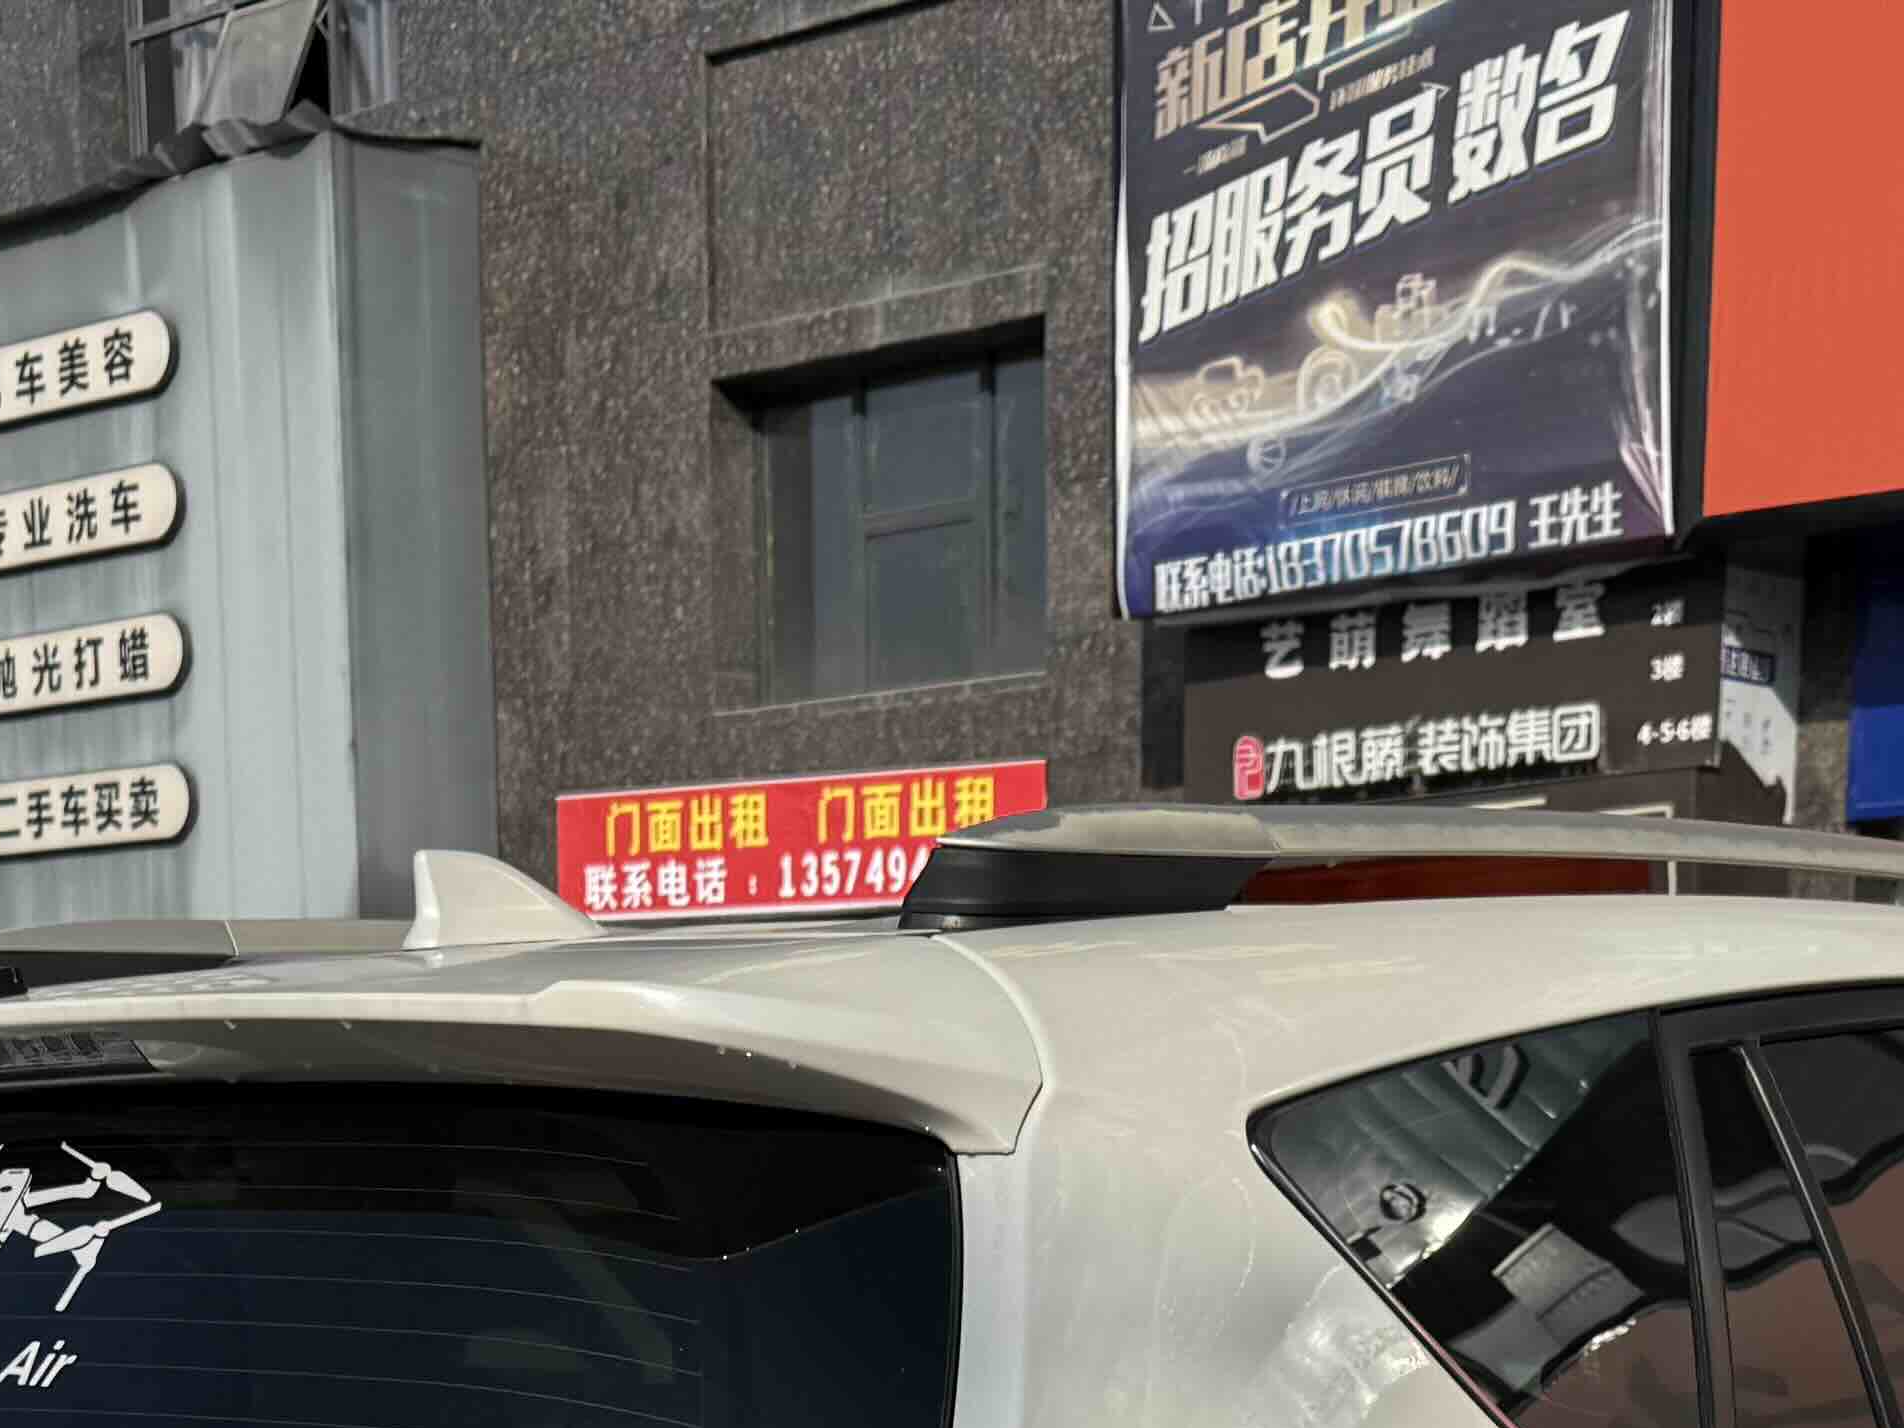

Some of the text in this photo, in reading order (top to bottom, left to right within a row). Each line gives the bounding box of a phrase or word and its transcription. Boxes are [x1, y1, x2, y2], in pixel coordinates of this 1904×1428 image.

[1139, 10, 1632, 343] 招服务员 数名
[1528, 481, 1625, 550] 王先生
[607, 775, 995, 856] 门面出租 门面出租
